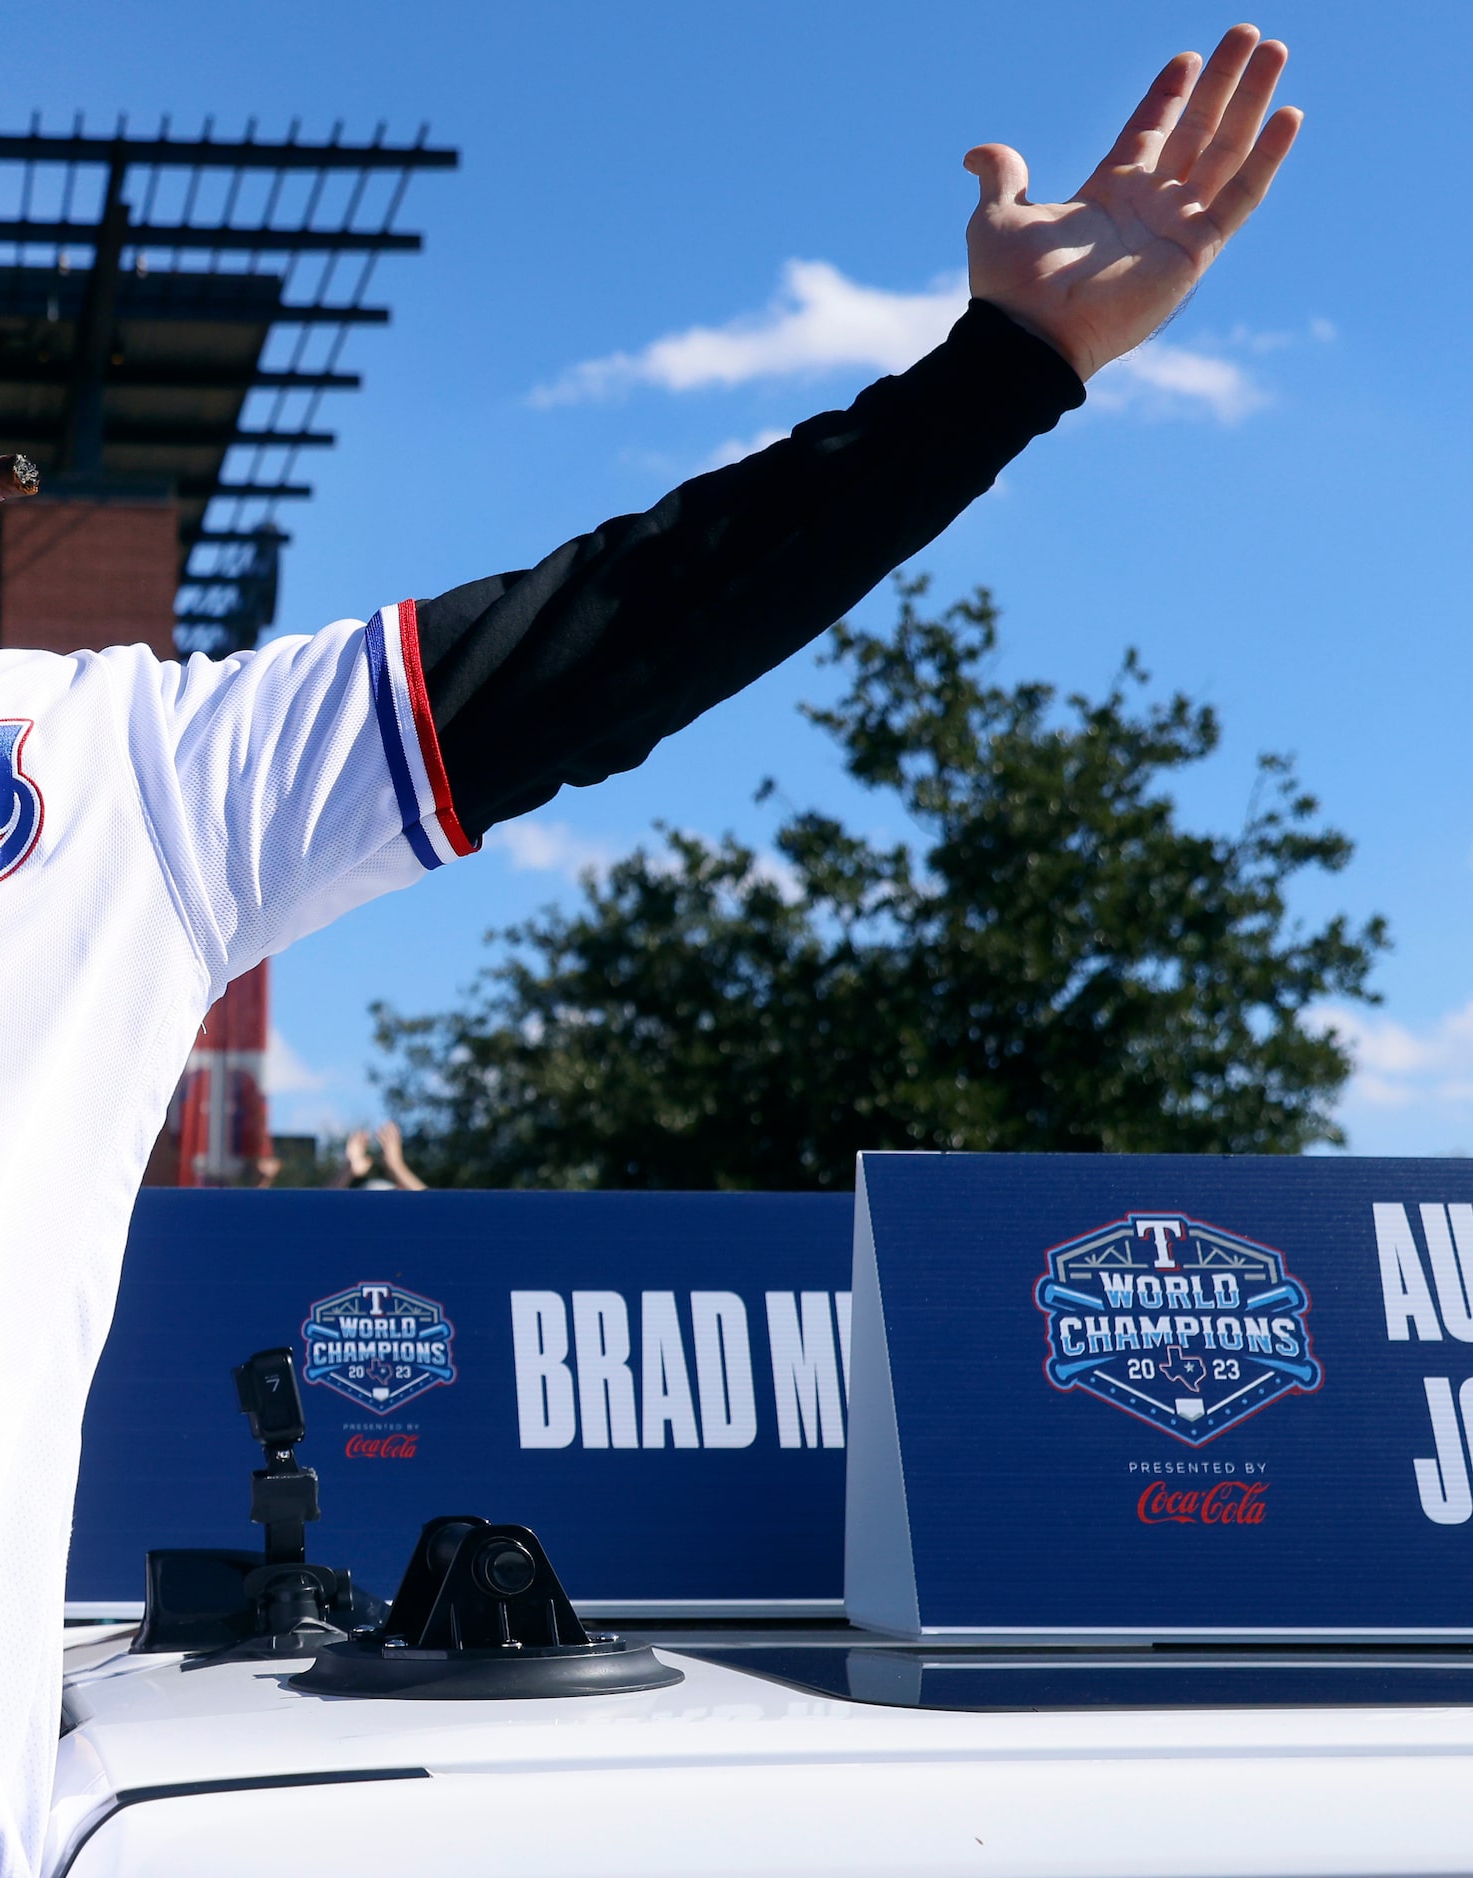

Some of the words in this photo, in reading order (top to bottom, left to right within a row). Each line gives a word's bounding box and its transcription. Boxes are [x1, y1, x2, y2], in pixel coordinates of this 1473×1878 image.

[1136, 1219, 1187, 1270] T
[362, 1286, 389, 1315] T
[1099, 1271, 1241, 1311] WORLD
[339, 1316, 416, 1339] WORLD
[1059, 1315, 1300, 1357] CHAMPIONS
[312, 1340, 446, 1366] CHAMPIONS
[348, 1365, 365, 1379] 20
[395, 1365, 412, 1379] 23
[510, 1290, 758, 1450] BRAD
[1127, 1358, 1156, 1380] 20
[1212, 1358, 1241, 1380] 23
[342, 1423, 403, 1431] PRESENTED
[407, 1423, 420, 1431] BY
[345, 1433, 420, 1459] Coca-Cola
[1128, 1461, 1236, 1475] PRESENTED
[1245, 1461, 1268, 1475] BY
[1137, 1480, 1271, 1525] Coca-Cola
